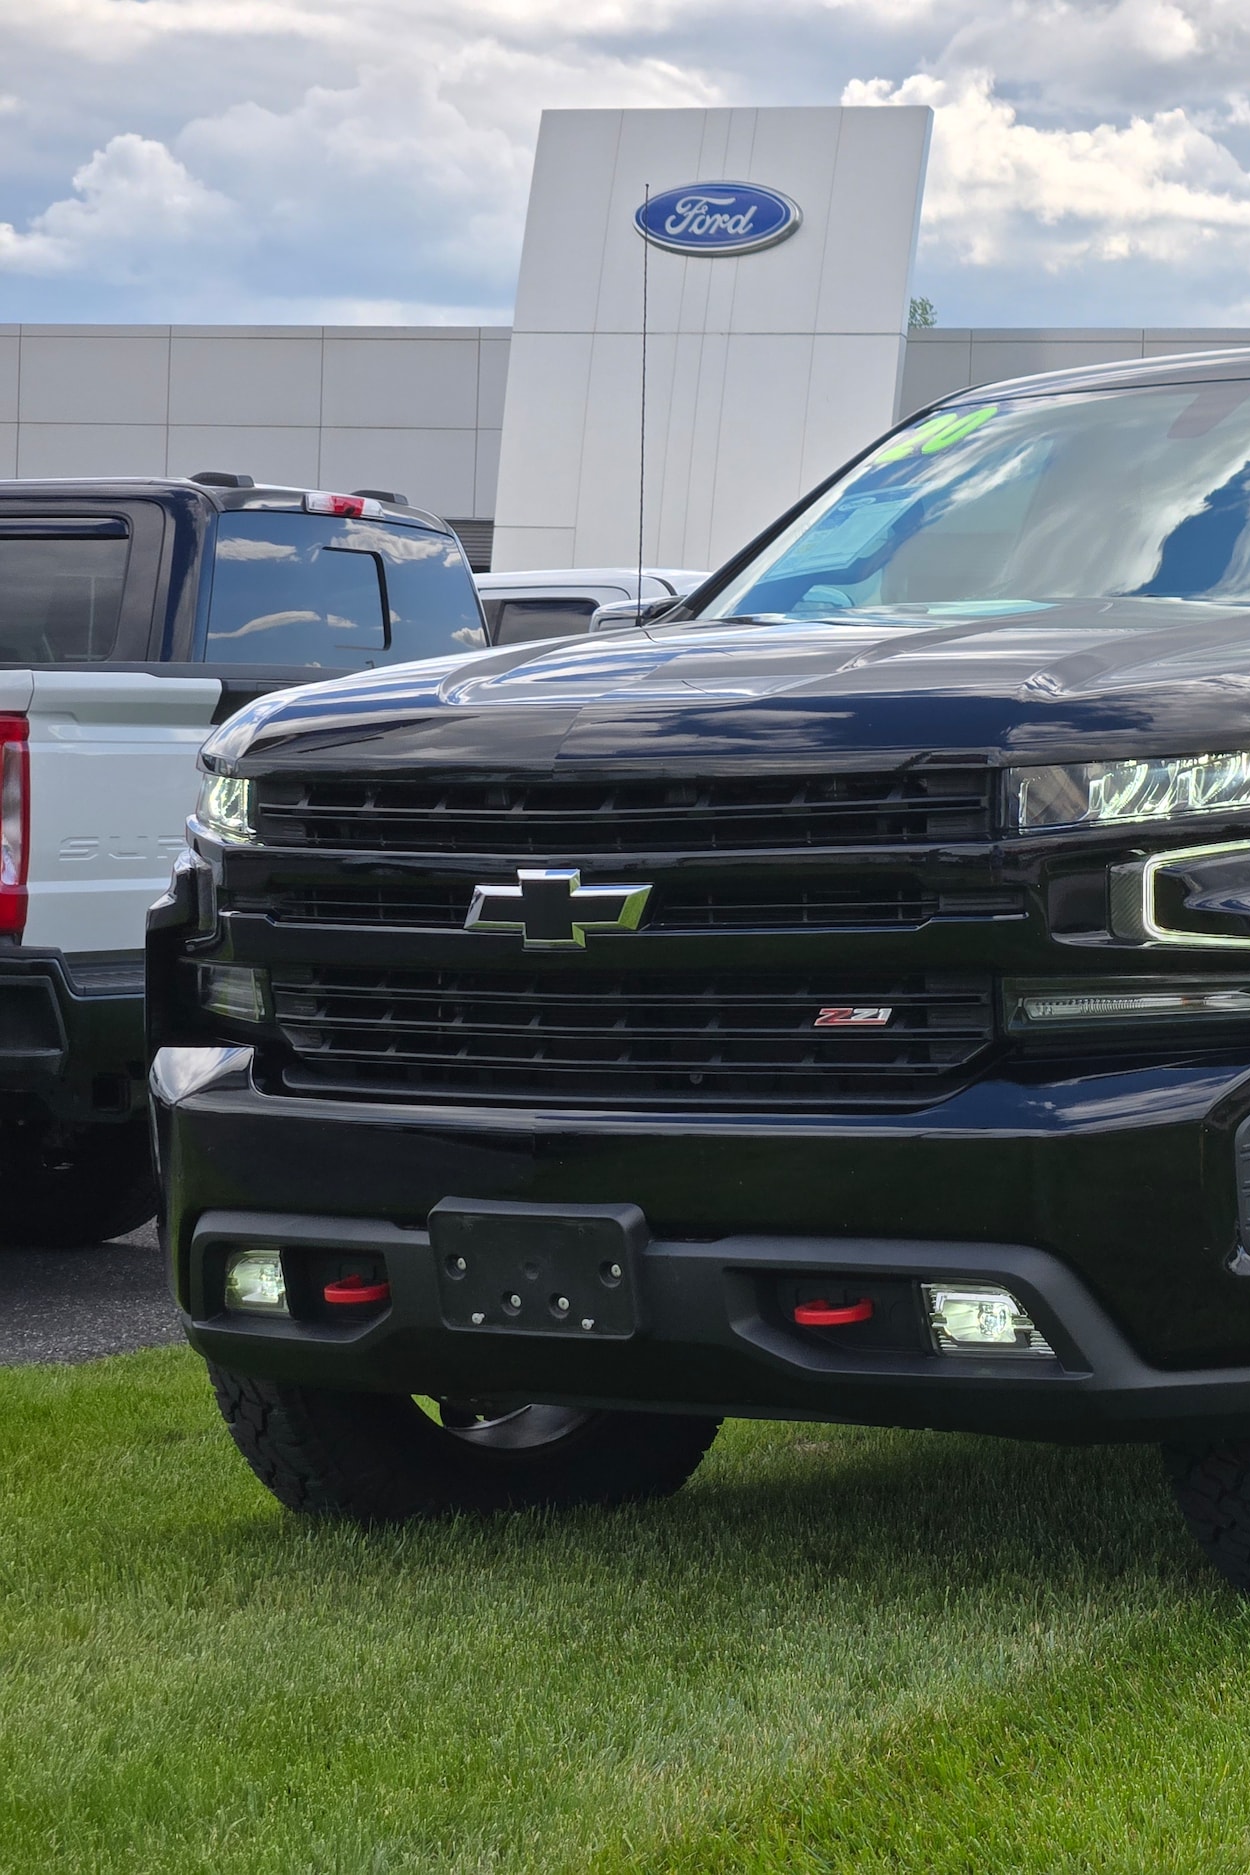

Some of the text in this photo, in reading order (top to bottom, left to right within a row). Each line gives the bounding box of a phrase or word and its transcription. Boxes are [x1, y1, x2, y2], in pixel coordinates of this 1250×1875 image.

[664, 195, 758, 236] Ford
[873, 406, 998, 465] 20
[814, 1007, 893, 1027] Z71
